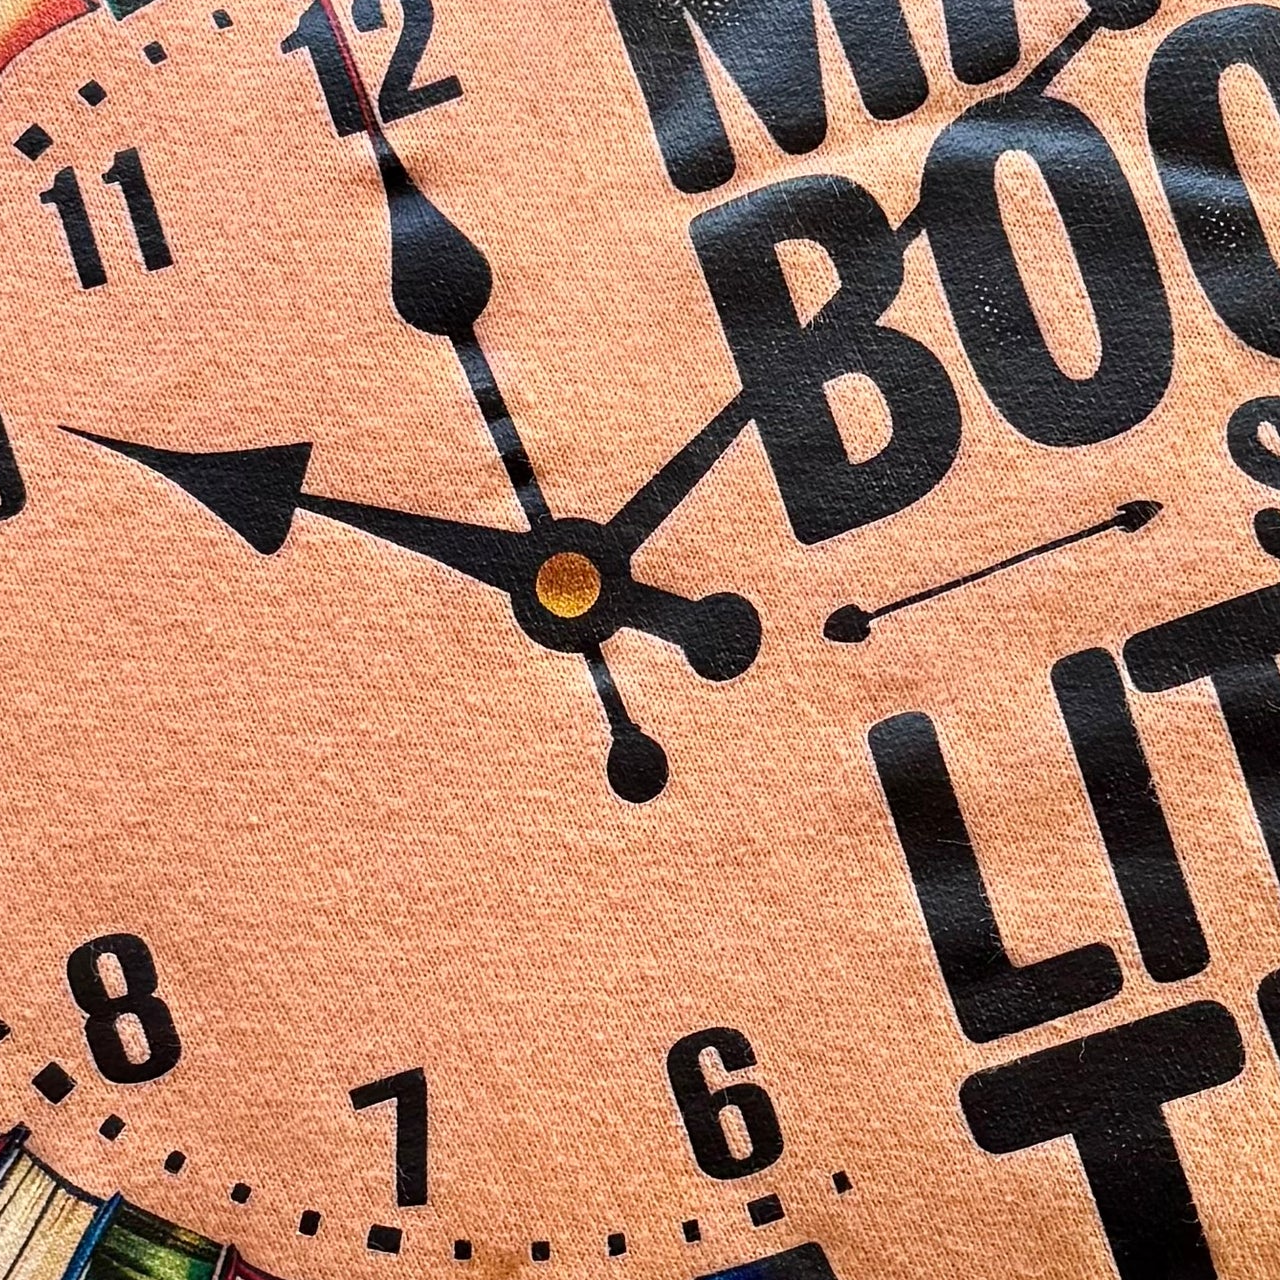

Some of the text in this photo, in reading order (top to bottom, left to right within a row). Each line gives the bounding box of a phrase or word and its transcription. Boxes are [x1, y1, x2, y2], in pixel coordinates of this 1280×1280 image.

[38, 146, 176, 290] 11
[65, 931, 183, 1086] 8
[347, 1065, 430, 1209] 7
[665, 1025, 786, 1182] 6
